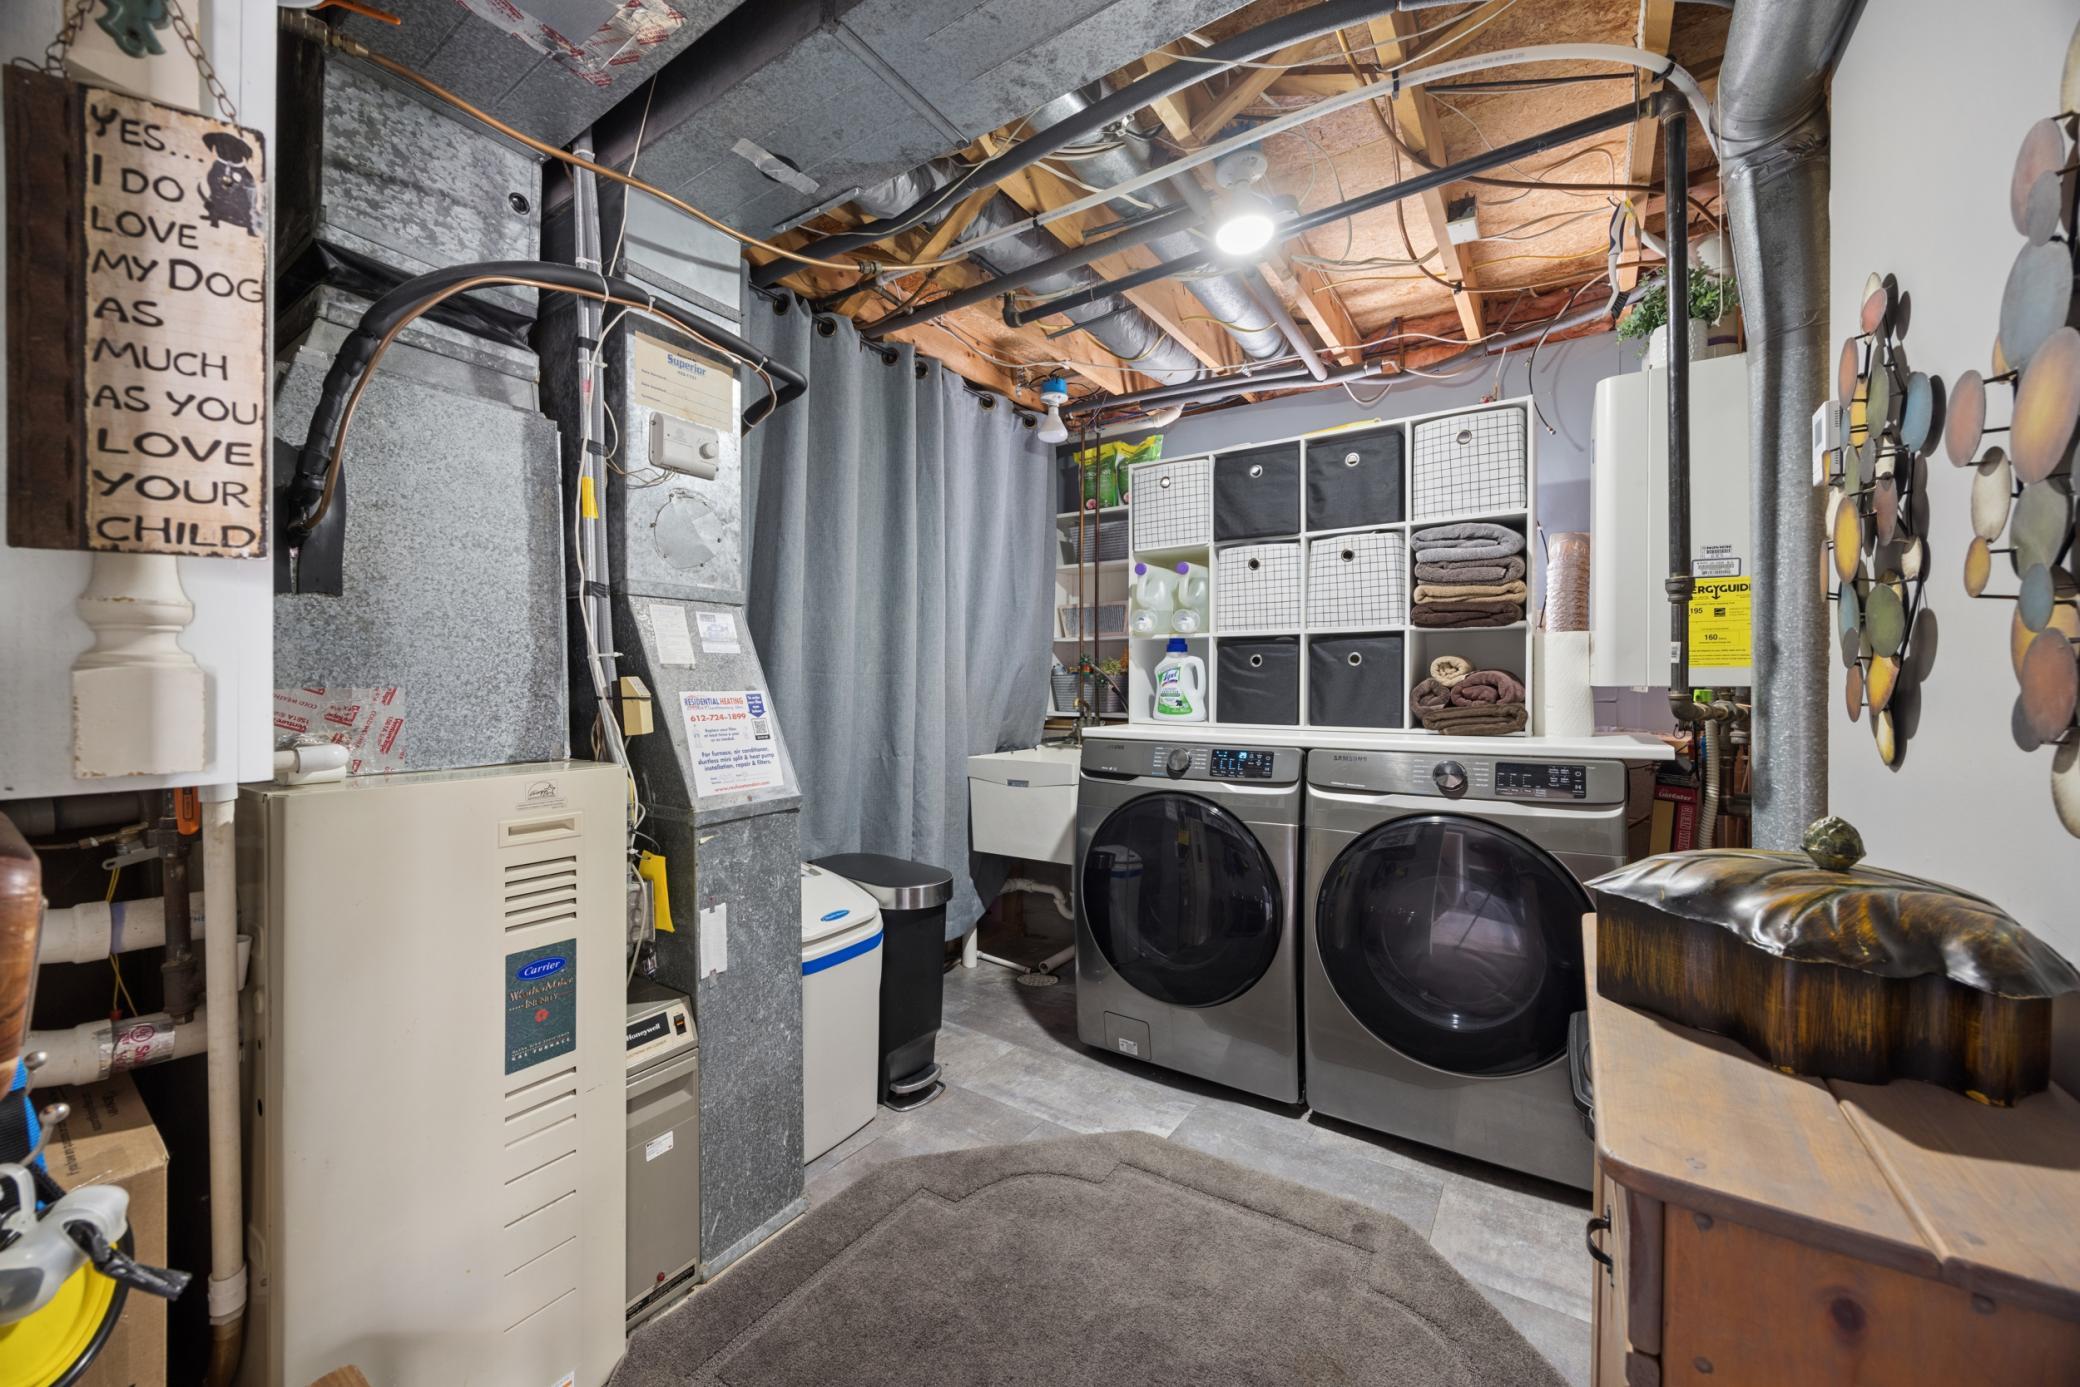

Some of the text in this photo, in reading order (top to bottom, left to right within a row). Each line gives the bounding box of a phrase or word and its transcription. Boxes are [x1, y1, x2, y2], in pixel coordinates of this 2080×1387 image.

[92, 153, 185, 203] I DO
[91, 204, 200, 250] LOVE
[92, 249, 264, 303] MY DOG
[93, 296, 164, 328] AS
[92, 336, 229, 381] MUCH
[667, 353, 707, 376] Superior
[93, 384, 259, 427] AS YOU
[97, 427, 256, 468] LOVE
[92, 469, 251, 508] YOUR
[96, 514, 258, 550] CHILD
[1692, 583, 1751, 596] ERGYGUID
[690, 713, 746, 722] 612-724-1899
[524, 960, 561, 977] Carrier
[626, 1023, 661, 1042] Honeywell
